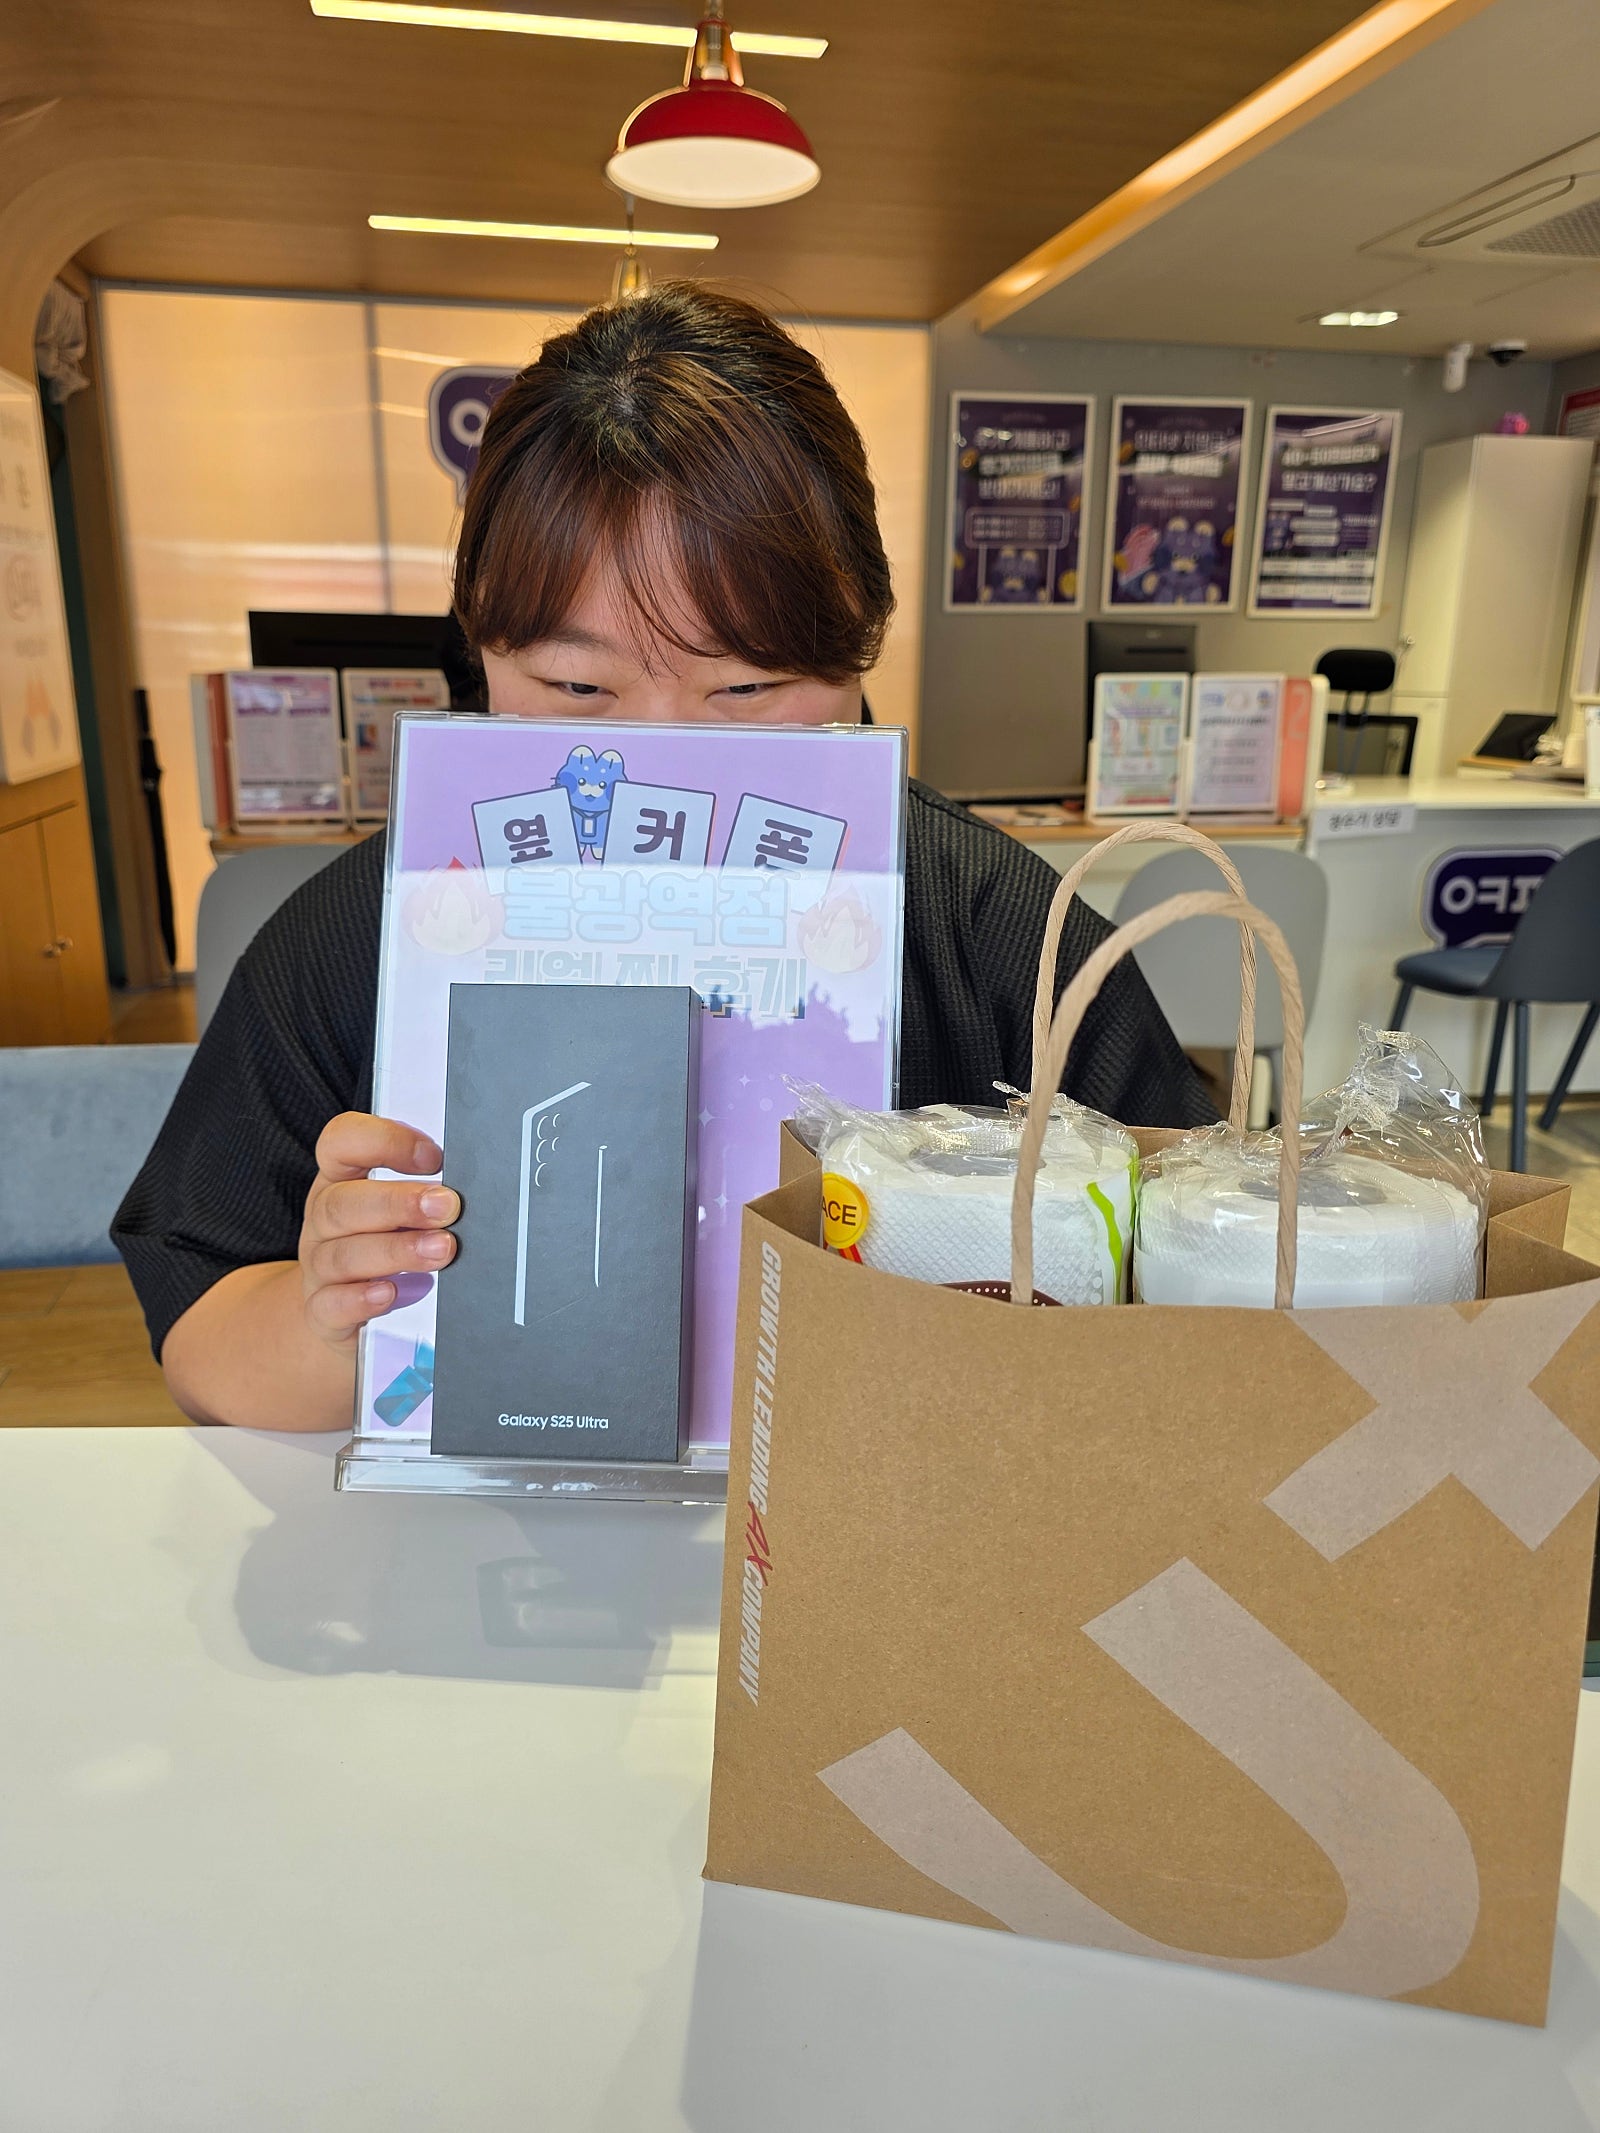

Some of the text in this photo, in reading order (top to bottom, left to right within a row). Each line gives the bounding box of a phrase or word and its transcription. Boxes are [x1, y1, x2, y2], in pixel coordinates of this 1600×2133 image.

[503, 807, 814, 880] 옆 커 폰
[502, 866, 788, 947] 불광역점
[756, 1241, 783, 1386] GROWTH
[497, 1413, 610, 1431] Galaxy S25 Ultra
[747, 1375, 774, 1516] LEADING
[738, 1557, 765, 1708] COMPANY
